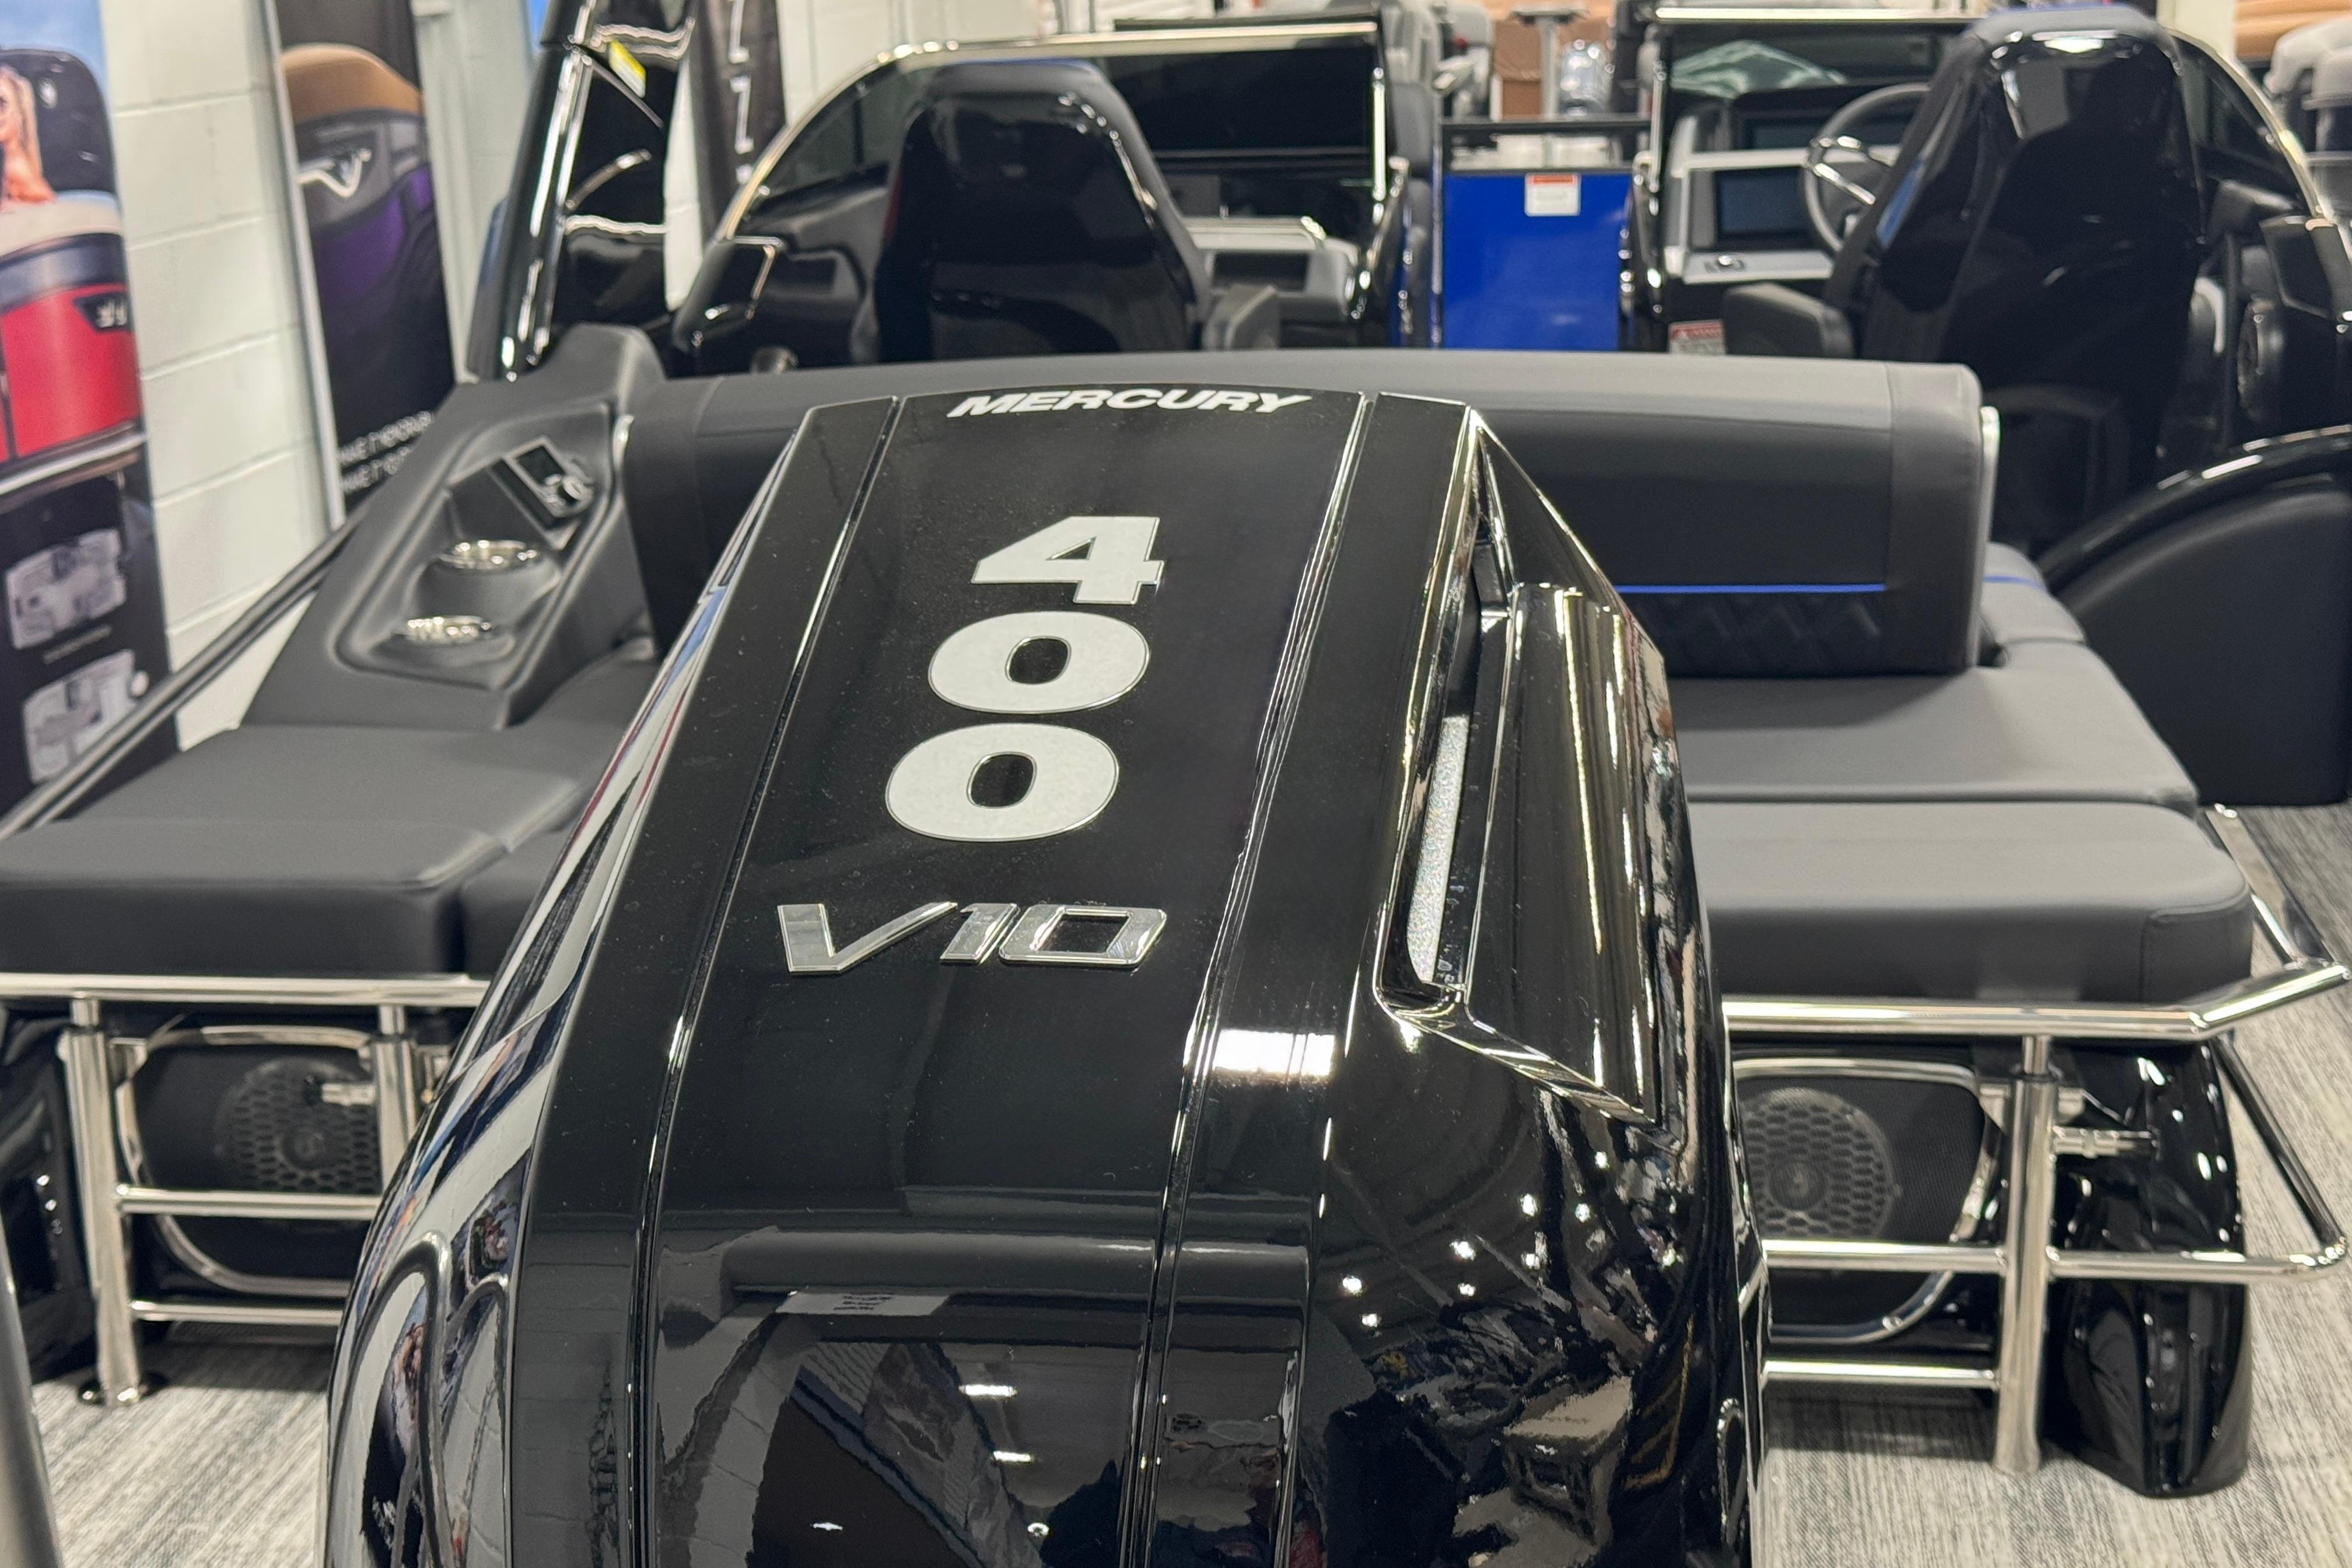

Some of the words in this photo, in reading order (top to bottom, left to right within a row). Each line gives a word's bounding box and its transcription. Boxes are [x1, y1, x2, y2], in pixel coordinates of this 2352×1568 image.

[946, 389, 1312, 418] MERCURY
[886, 516, 1164, 842] 400
[778, 902, 1167, 973] V10
